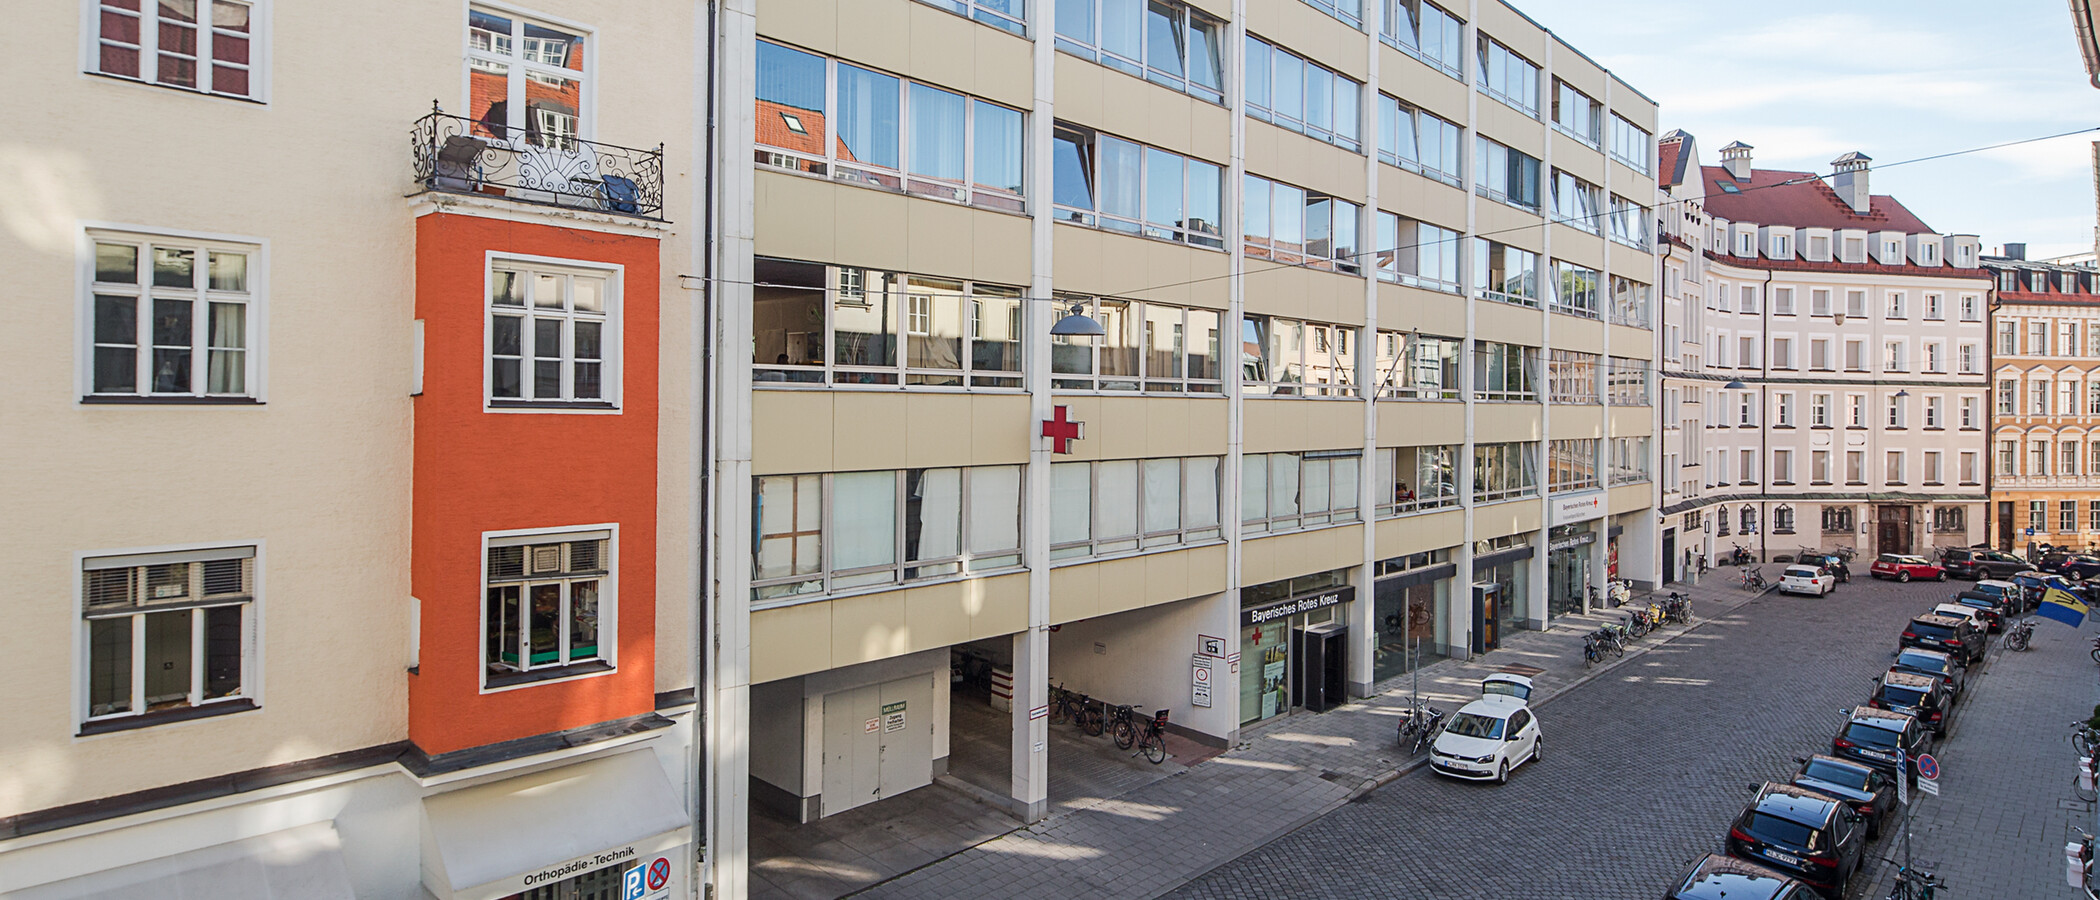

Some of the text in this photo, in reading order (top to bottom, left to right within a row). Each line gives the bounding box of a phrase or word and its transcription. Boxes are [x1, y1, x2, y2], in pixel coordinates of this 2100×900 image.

[1251, 593, 1339, 623] Bayerisches Rotes Kreuz
[626, 871, 640, 900] P
